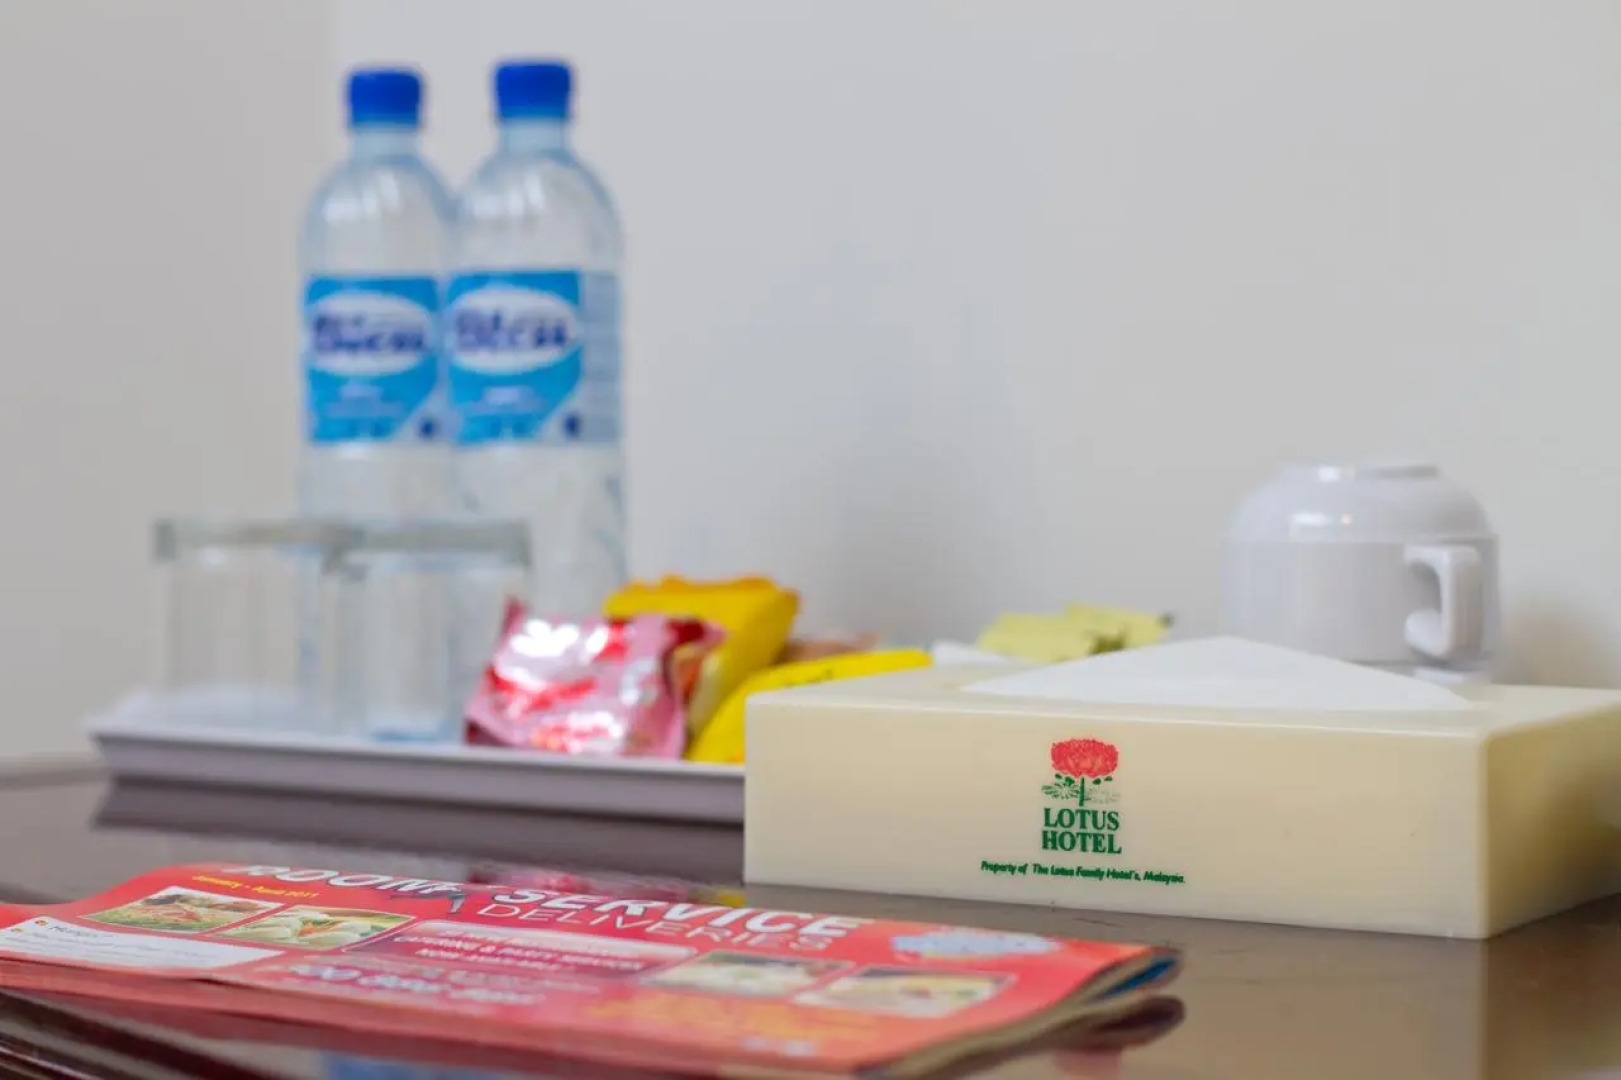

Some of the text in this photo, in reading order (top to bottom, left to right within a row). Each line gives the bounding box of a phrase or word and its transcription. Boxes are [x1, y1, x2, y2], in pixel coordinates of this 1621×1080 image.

[1043, 807, 1120, 831] LOTUS
[1041, 830, 1122, 855] HOTEL
[981, 860, 1017, 875] Property
[1018, 862, 1028, 875] of
[1032, 864, 1049, 875] The
[1050, 865, 1075, 877] Lotus
[1076, 866, 1105, 881] Family
[491, 885, 872, 938] SERVICE
[478, 903, 838, 952] DELIVERIES
